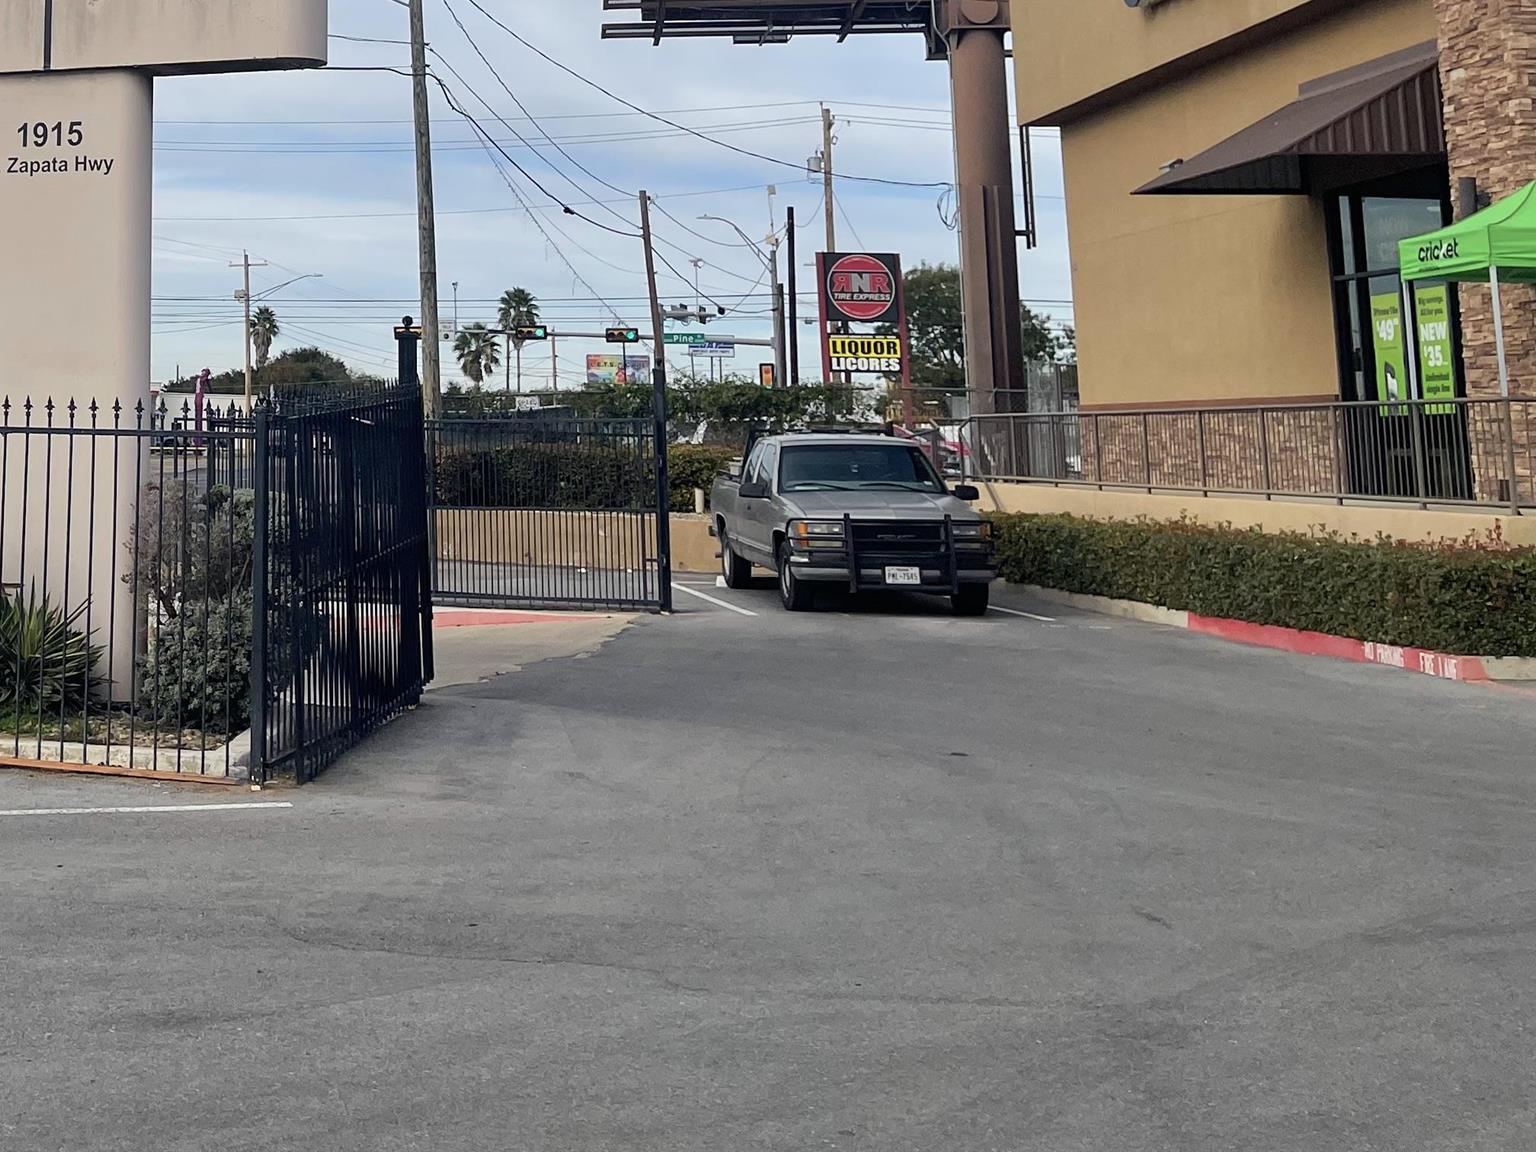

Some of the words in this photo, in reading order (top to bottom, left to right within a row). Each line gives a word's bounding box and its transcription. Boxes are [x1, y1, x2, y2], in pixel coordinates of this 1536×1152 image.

[17, 121, 83, 148] 1915
[7, 156, 68, 177] Zapata
[75, 155, 114, 175] Hwy
[1418, 238, 1460, 263] cricket
[834, 292, 852, 301] TIRE
[853, 293, 891, 301] EXPRESS
[673, 334, 695, 343] Pine
[1420, 321, 1448, 342] NEW
[831, 340, 898, 356] LIQUOR
[831, 357, 901, 371] LICORES
